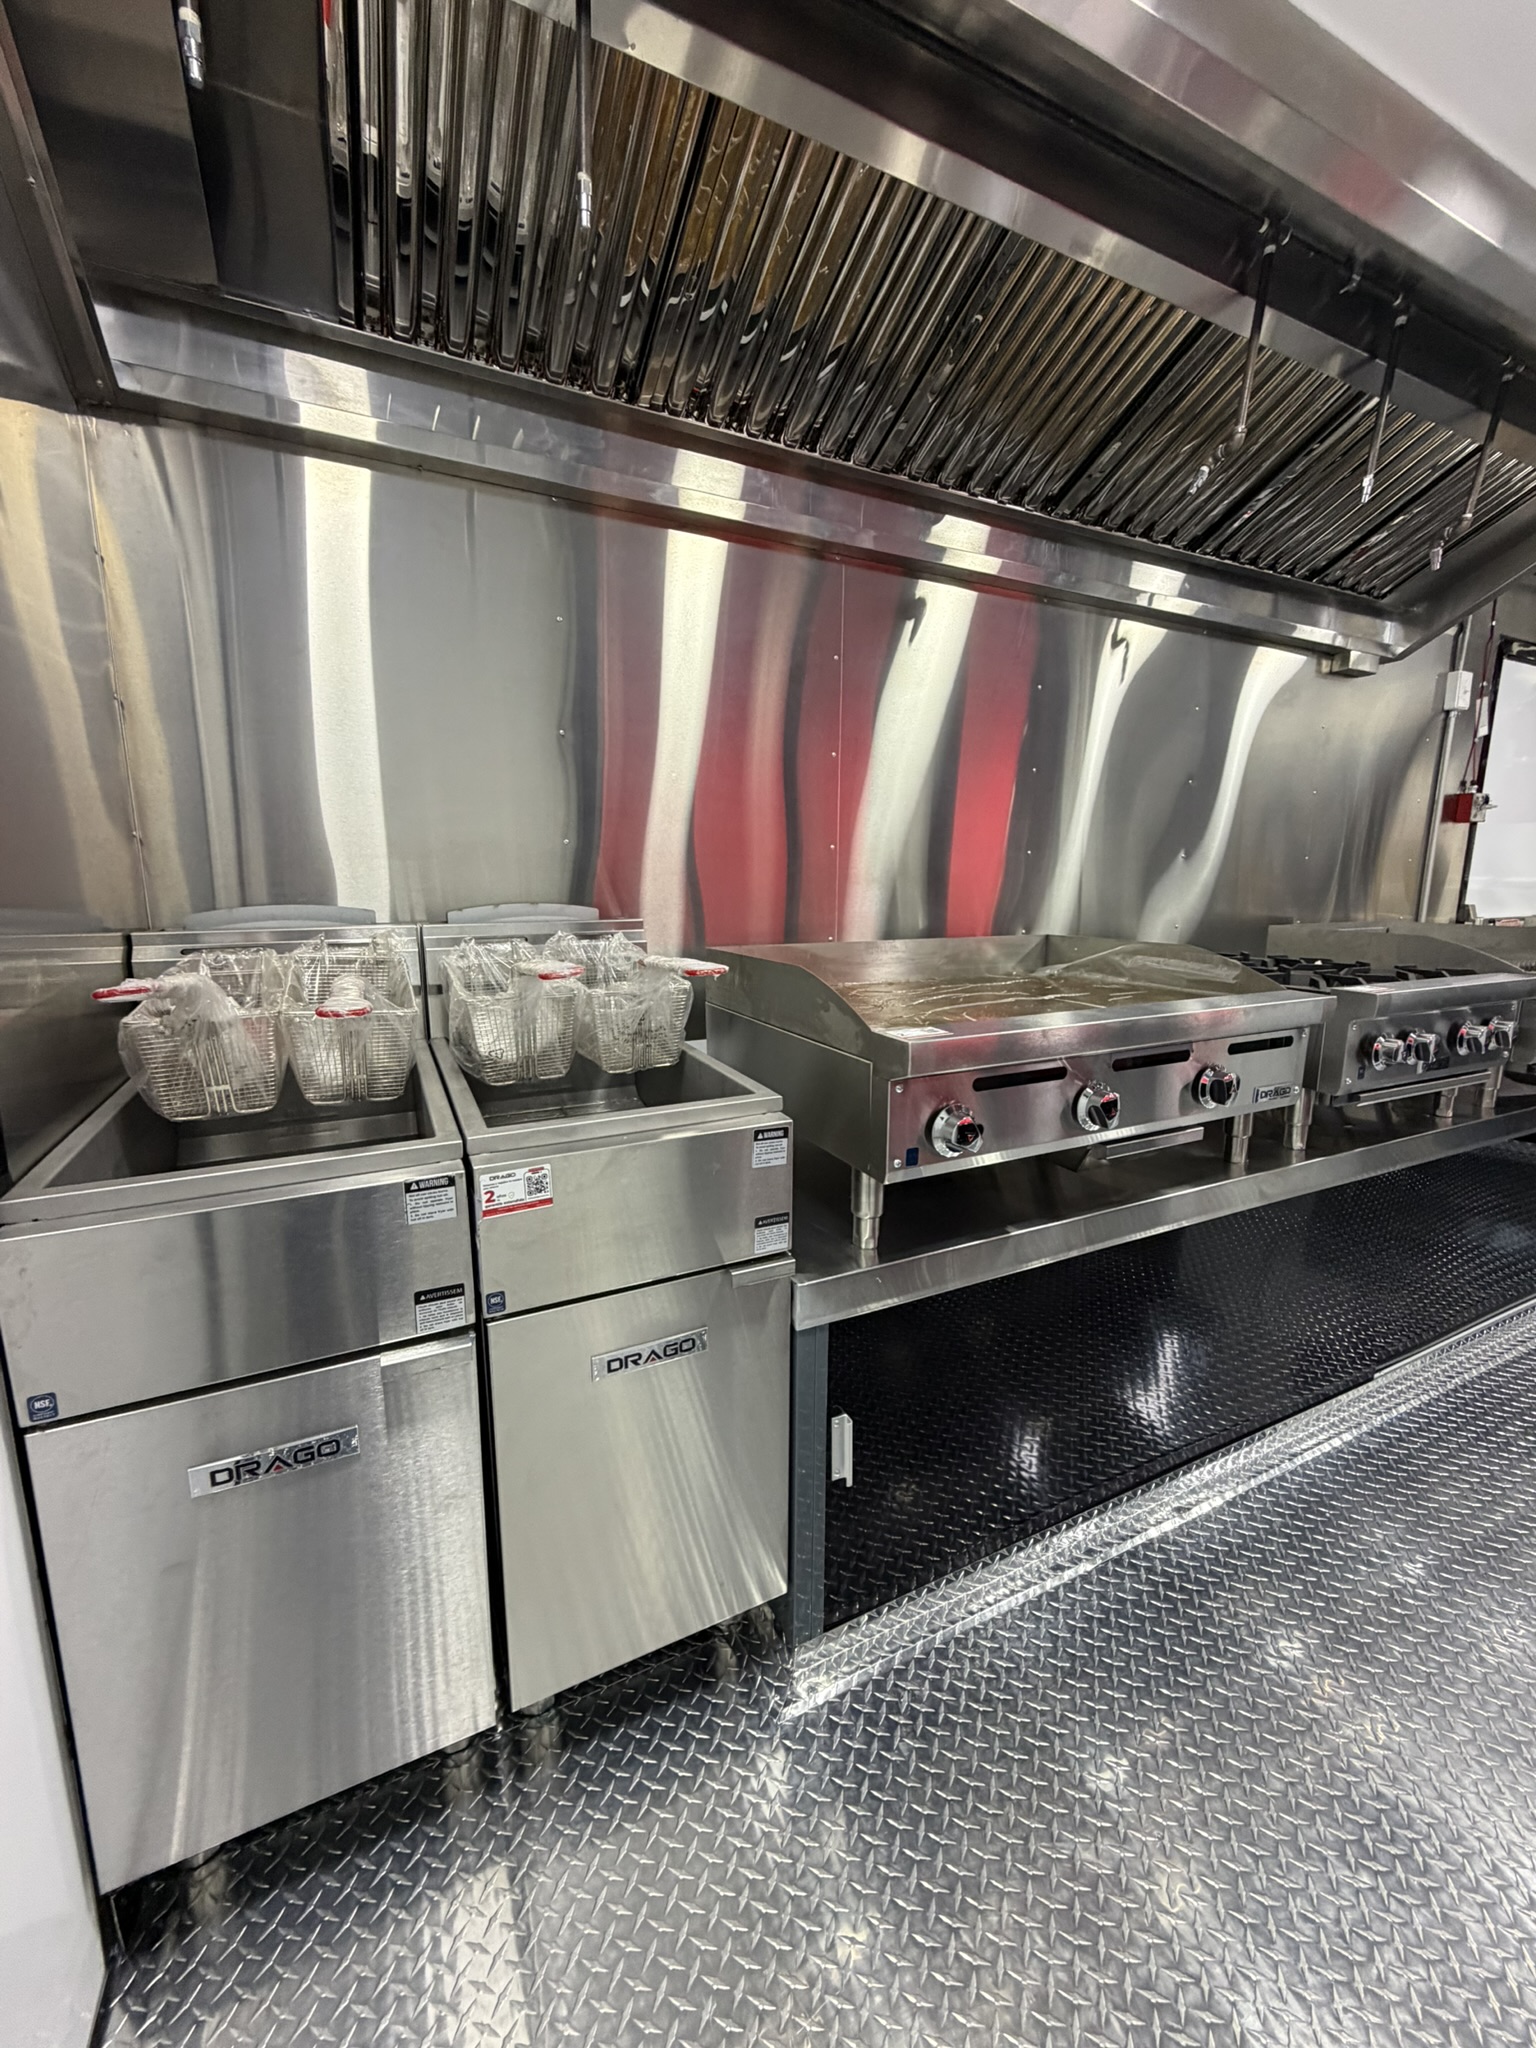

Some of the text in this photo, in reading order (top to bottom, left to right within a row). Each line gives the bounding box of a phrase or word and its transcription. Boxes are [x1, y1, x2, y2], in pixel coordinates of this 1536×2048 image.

[489, 1172, 516, 1181] DRAGO
[418, 1177, 449, 1189] WARNING
[483, 1190, 496, 1204] 2
[490, 1295, 501, 1304] NSF
[606, 1337, 696, 1374] DRAGO
[33, 1398, 50, 1410] NSF
[209, 1438, 341, 1488] DRAGO
